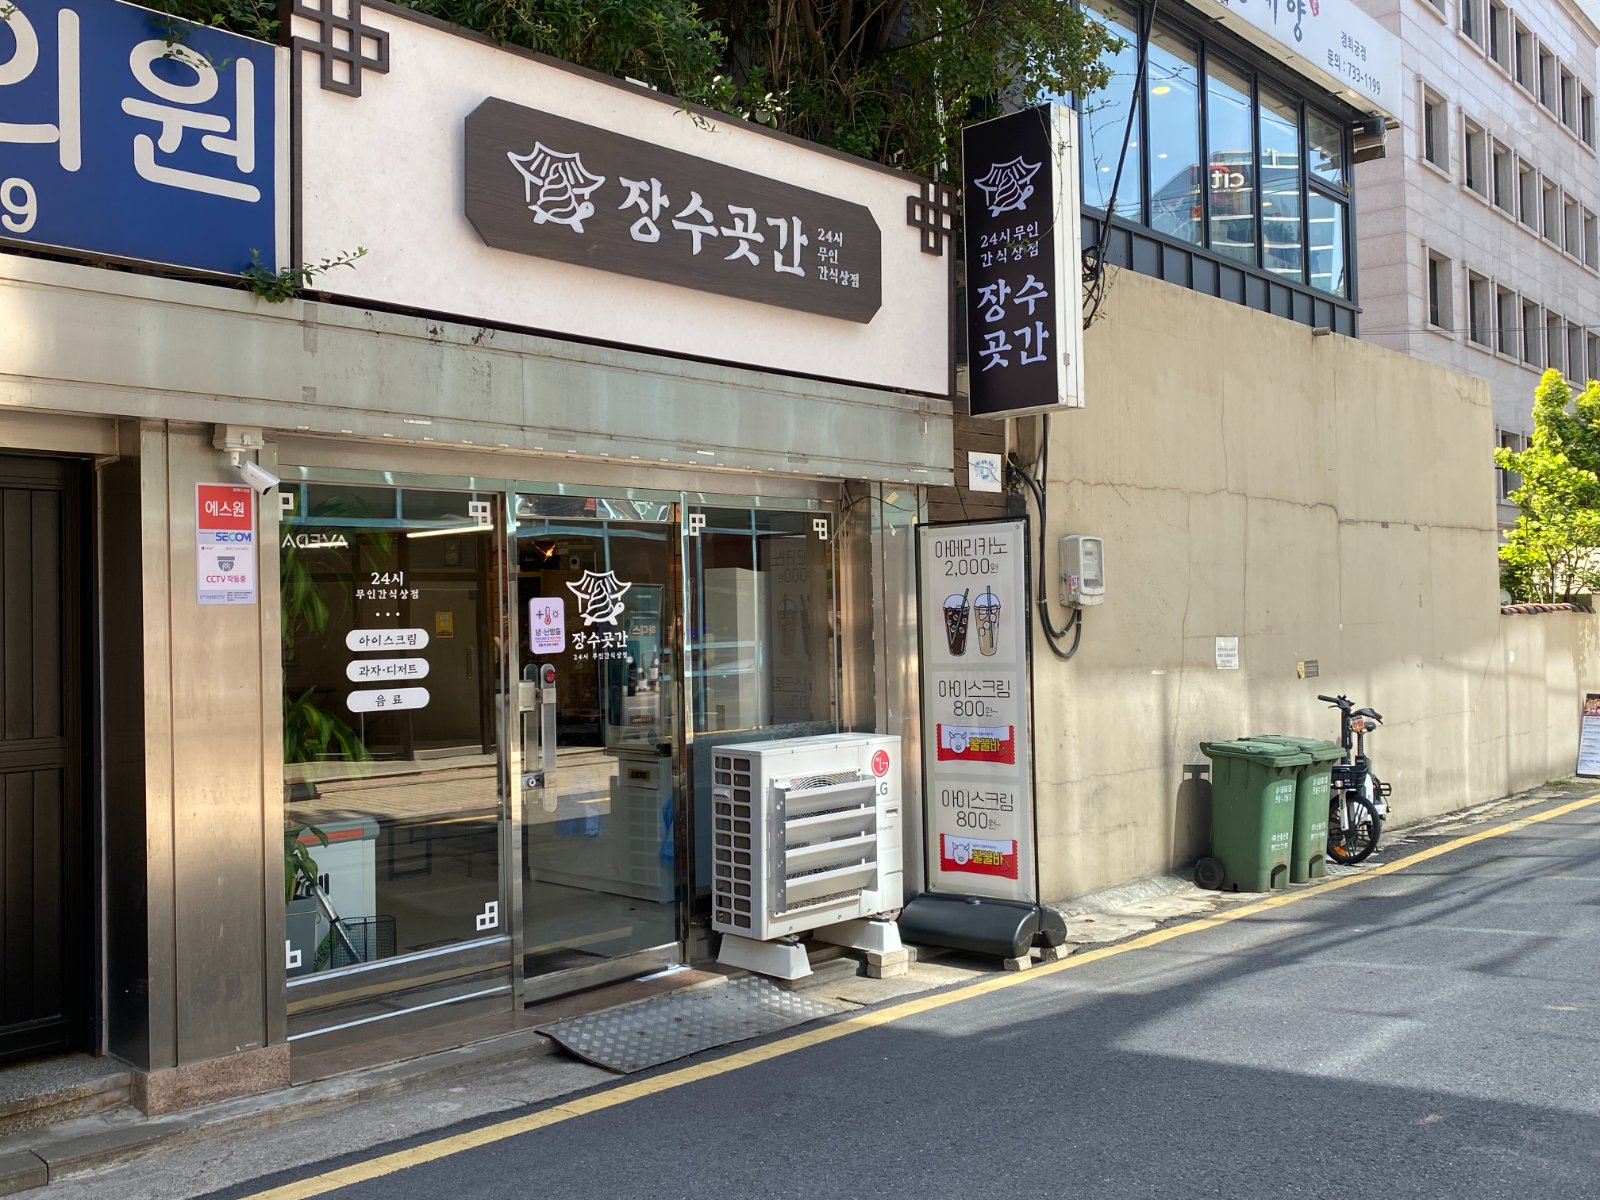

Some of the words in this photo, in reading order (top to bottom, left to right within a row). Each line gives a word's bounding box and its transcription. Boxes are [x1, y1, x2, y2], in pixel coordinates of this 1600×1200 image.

[1341, 31, 1367, 62] 경희궁점
[1328, 48, 1341, 72] 문의
[1347, 62, 1381, 95] 733-1199
[618, 176, 809, 278] 장수곳간
[980, 228, 1010, 248] 24시
[1013, 221, 1040, 241] 무인
[817, 228, 843, 247] 24시
[817, 247, 839, 264] 무인
[980, 241, 1040, 268] 간식상점
[817, 265, 860, 288] 간식상점
[977, 274, 1049, 323] 장수
[978, 321, 1050, 373] 곳간
[205, 500, 245, 518] 에스원
[216, 532, 251, 542] SECOM
[935, 537, 1008, 558] 아메리카노
[945, 558, 999, 577] 2,000원
[206, 575, 226, 583] CCTV
[227, 575, 247, 583] 작동중
[371, 571, 404, 586] 24시
[355, 589, 419, 600] 무인간식상점
[359, 633, 418, 647] 아이스크림
[571, 630, 629, 650] 장수곳간
[359, 663, 419, 677] 과자·디저트
[938, 679, 1011, 699] 아이스크림
[941, 789, 1013, 812] 아이스크림
